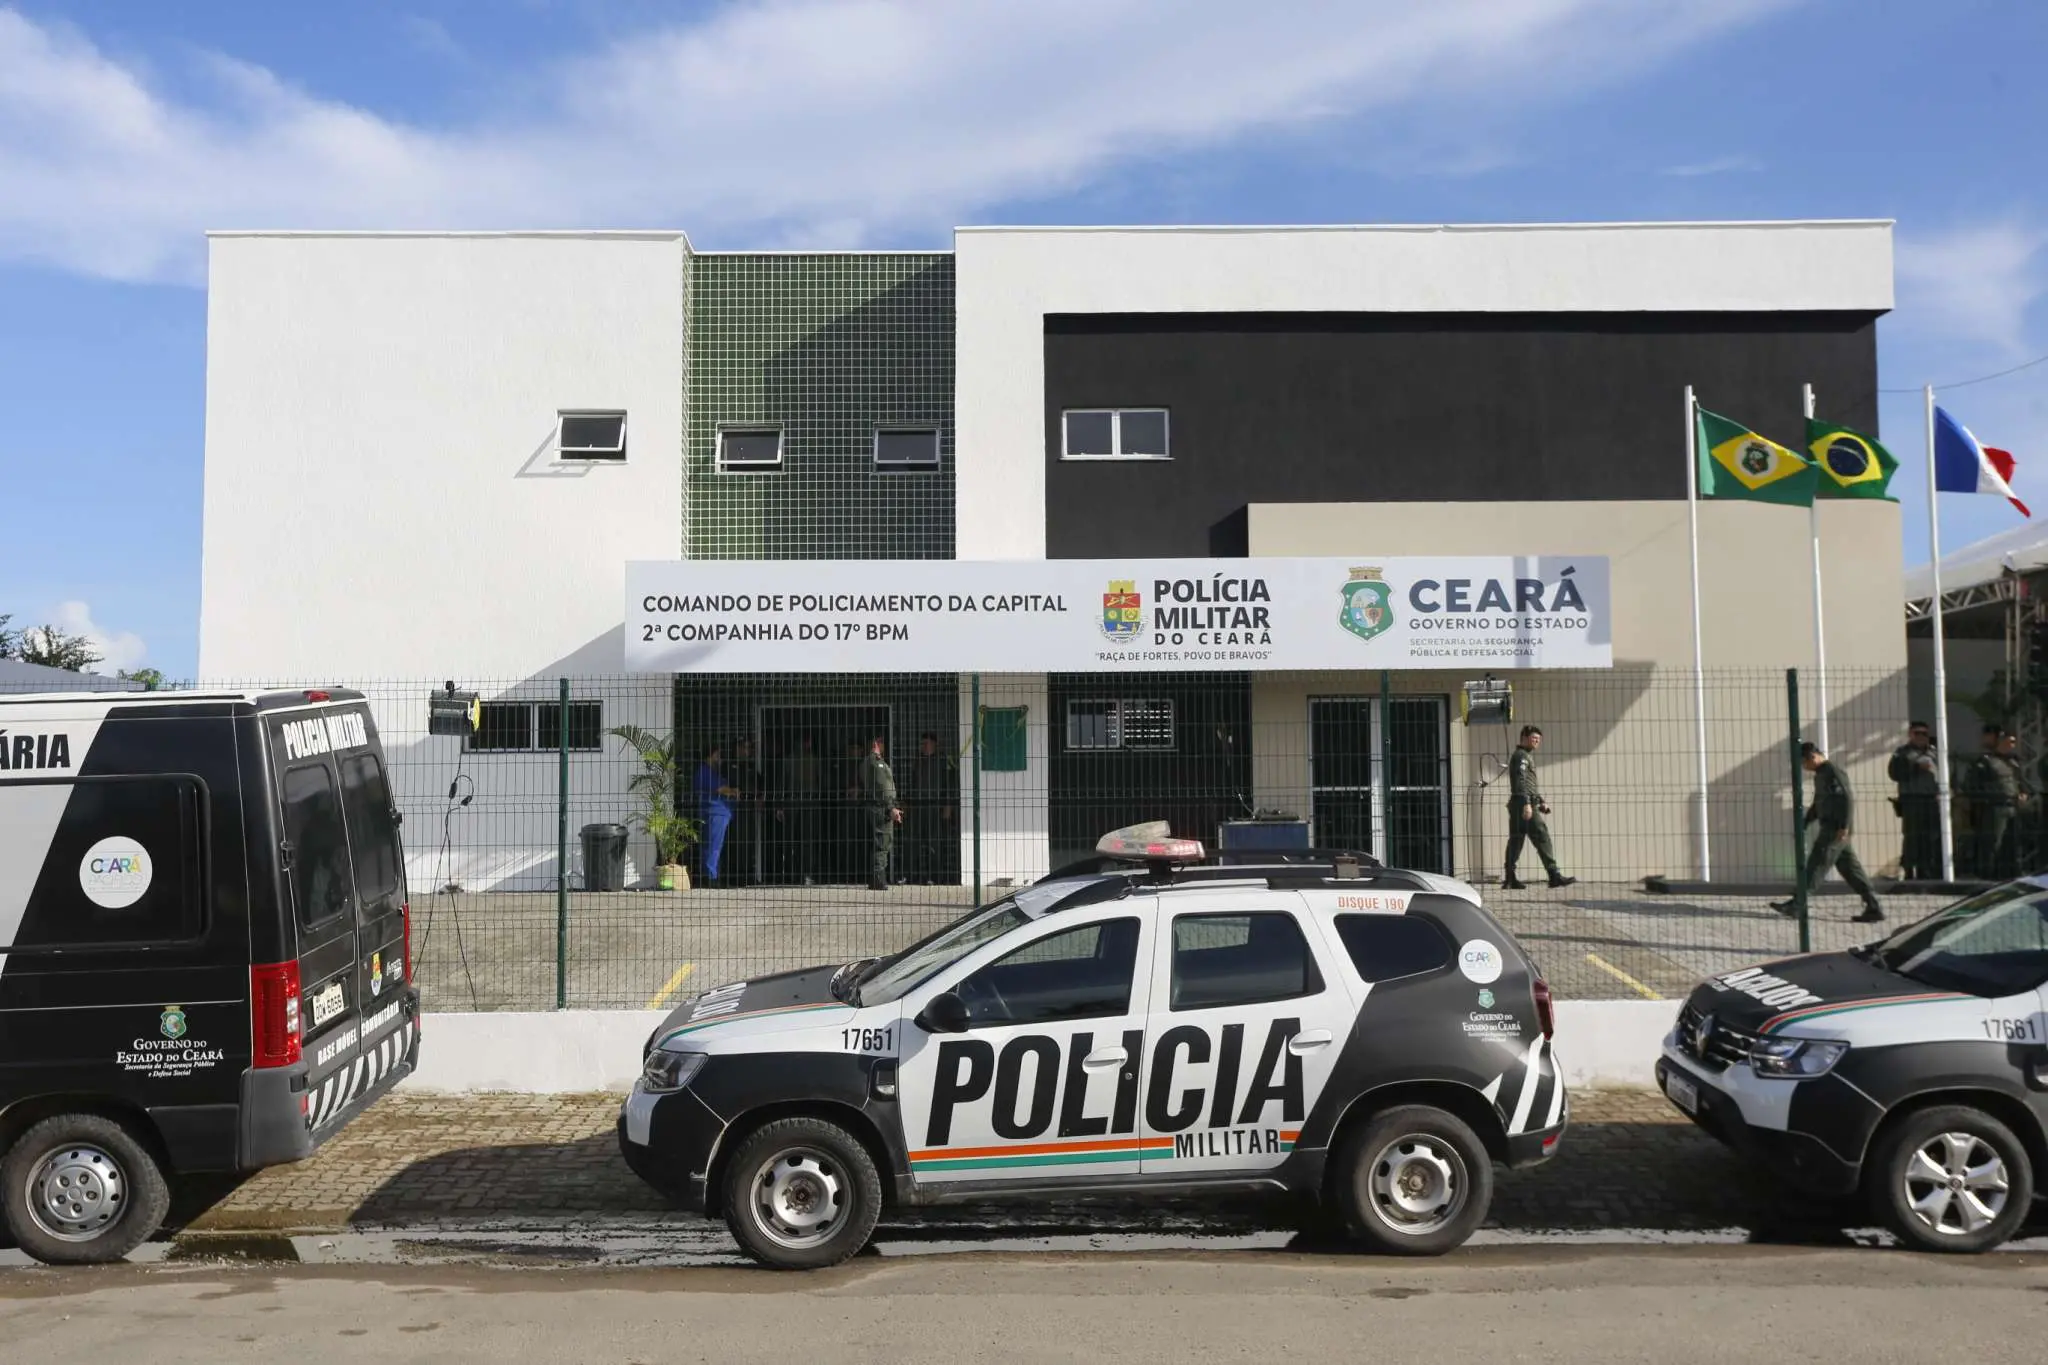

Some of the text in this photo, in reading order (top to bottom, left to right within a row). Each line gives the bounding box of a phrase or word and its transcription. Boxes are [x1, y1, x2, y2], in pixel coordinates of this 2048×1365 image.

[1154, 572, 1271, 603] POLÍCIA
[1409, 565, 1587, 614] CEARÁ
[642, 594, 1067, 613] COMANDO DE POLICIAMENTO DA CAPITAL
[1154, 606, 1271, 630] MILITAR
[1409, 617, 1588, 630] GOVERNO DO ESTADO
[642, 624, 662, 642] 2ª
[666, 624, 793, 641] COMPANHIA
[799, 624, 829, 641] DO
[866, 623, 909, 641] BPM
[1155, 632, 1184, 645] DO
[1199, 629, 1272, 645] CEARÁ
[1410, 637, 1544, 647] SECRETARIA DA SEGURANÇA
[1128, 652, 1140, 661] DE
[1143, 652, 1181, 662] FORTES,
[1184, 652, 1211, 661] POVO
[1214, 651, 1228, 660] DE
[1410, 647, 1450, 656] PÚBLICA
[1461, 648, 1498, 656] DEFESA
[1500, 648, 1535, 656] SOCIAL
[1338, 896, 1404, 911] DISQUE 190
[841, 1028, 892, 1051] 17651
[1981, 1019, 2036, 1042] 17661
[133, 1038, 207, 1050] GOVERNO DO
[318, 1042, 335, 1066] BASE
[336, 1028, 357, 1055] MÓVEL
[116, 1048, 224, 1064] ESTADO DO CEARÁ
[926, 1017, 1305, 1147] POLICIA
[1175, 1128, 1279, 1159] MILITAR
